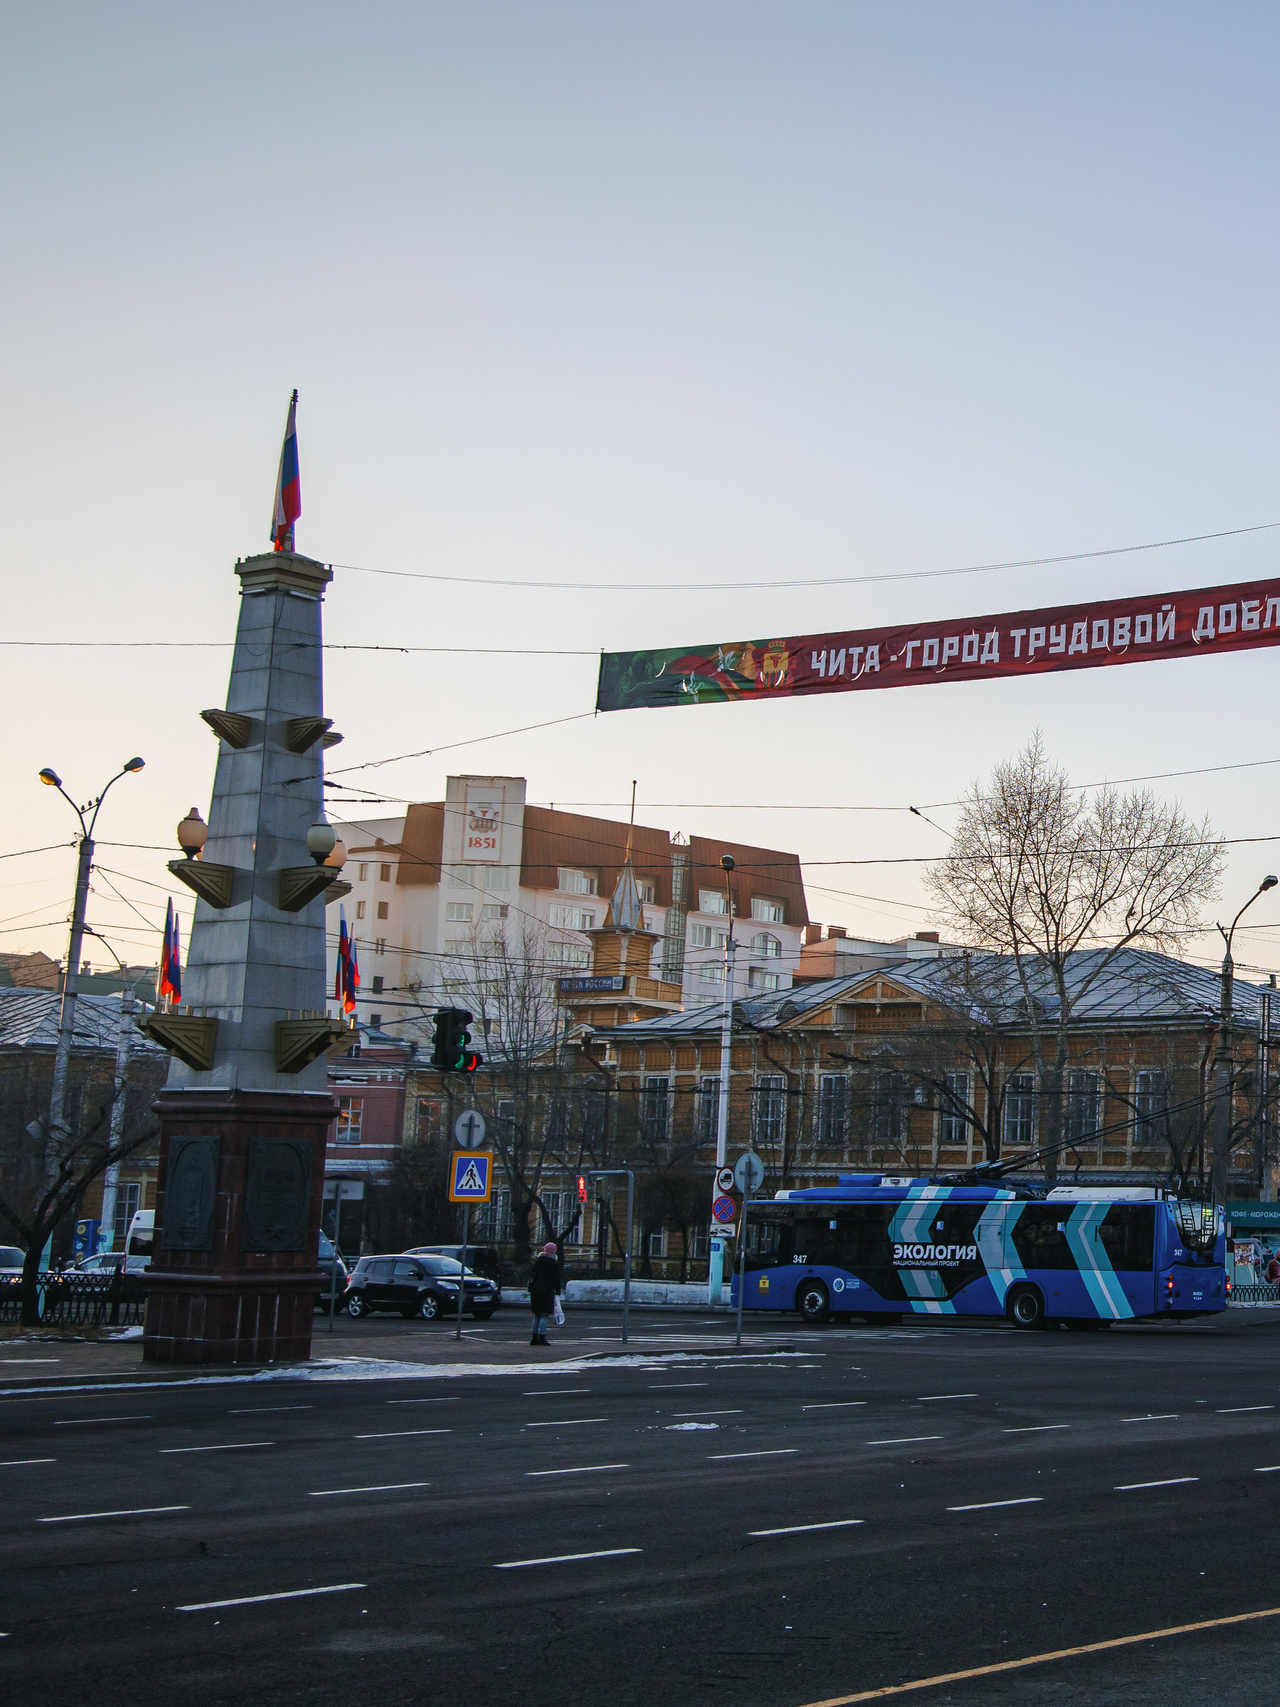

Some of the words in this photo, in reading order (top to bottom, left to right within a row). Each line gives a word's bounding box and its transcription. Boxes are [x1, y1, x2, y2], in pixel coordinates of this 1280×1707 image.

[811, 646, 880, 677] ЧИТА
[905, 631, 1000, 668] ГОРОД
[1010, 604, 1176, 657] ТРУДОВОЙ
[468, 836, 496, 849] 1851
[585, 978, 612, 989] РОССИИ
[893, 1244, 977, 1260] ЭКОЛОГИЯ
[792, 1254, 807, 1263] 347
[892, 1259, 938, 1267] НАЦИОНАЛЬНЫЙ
